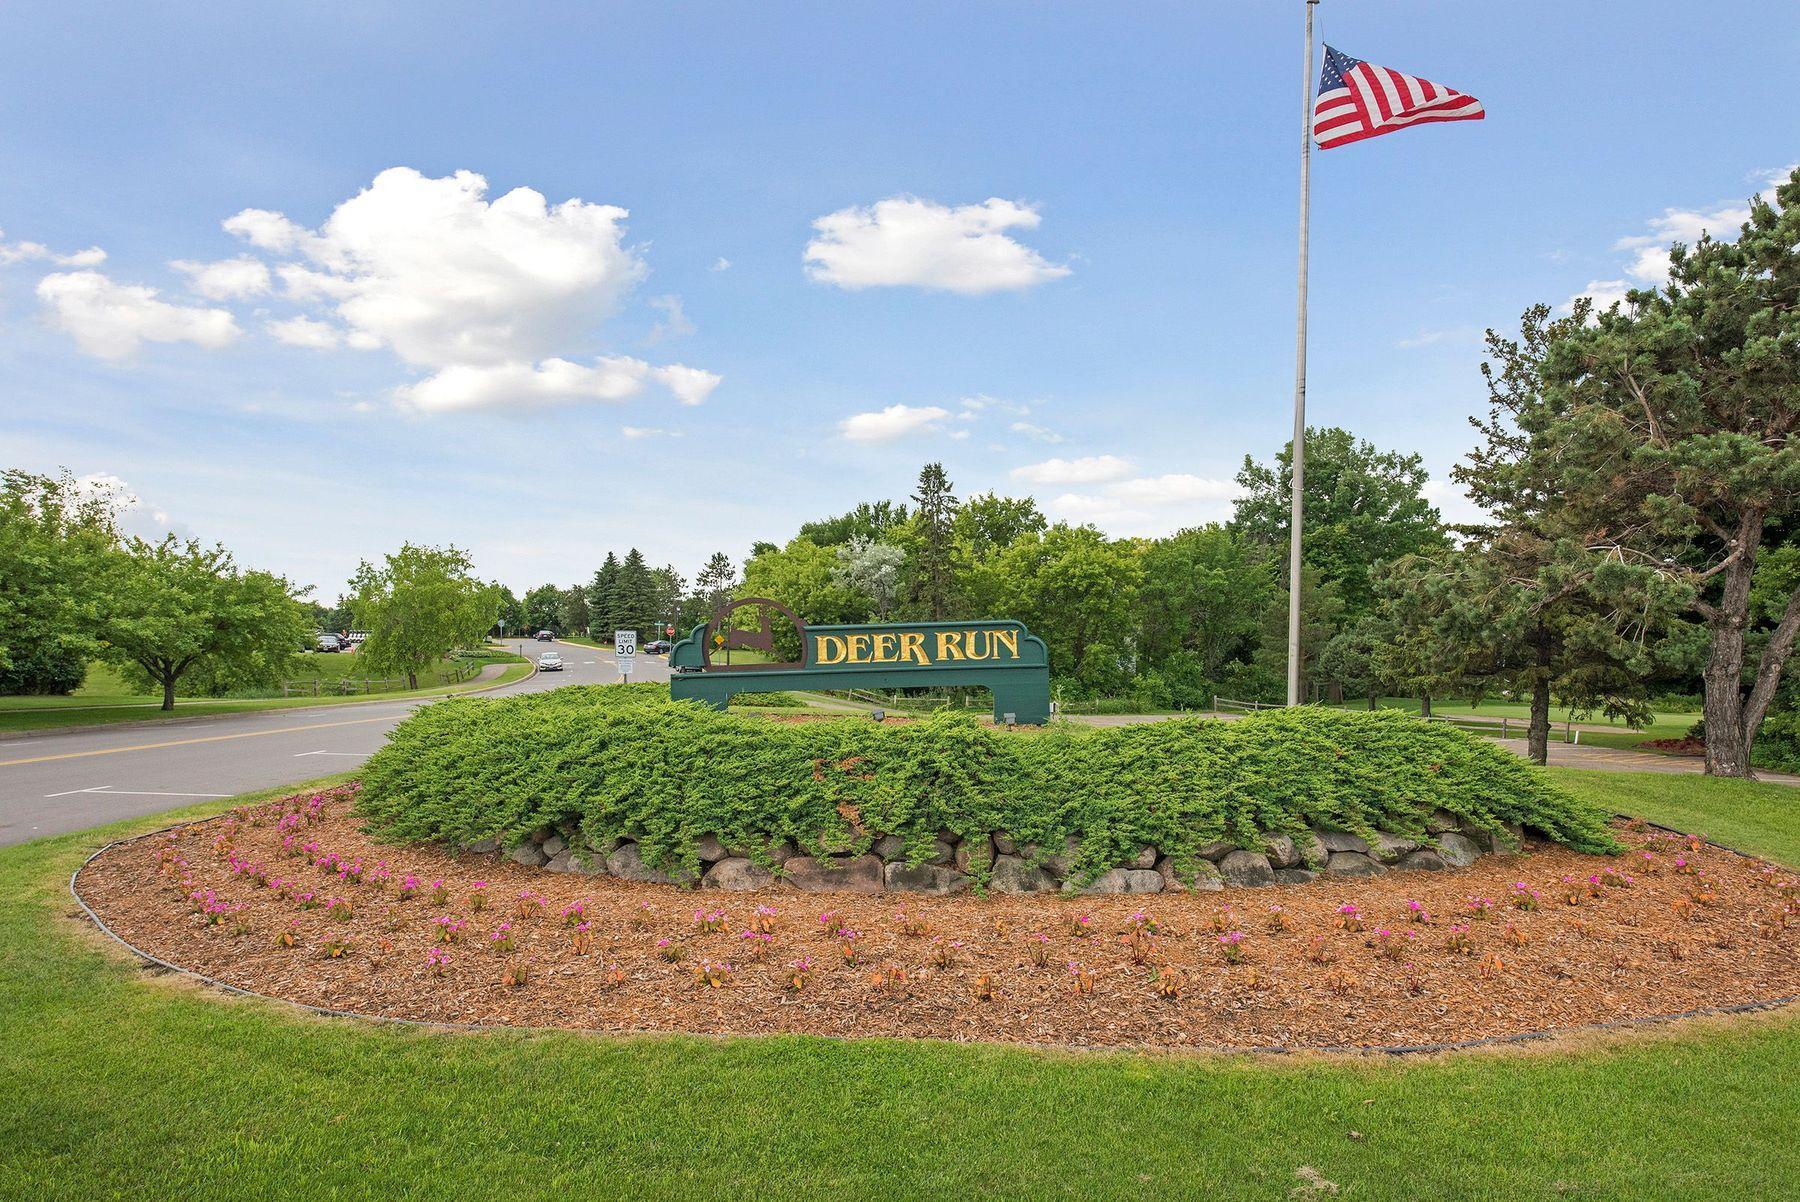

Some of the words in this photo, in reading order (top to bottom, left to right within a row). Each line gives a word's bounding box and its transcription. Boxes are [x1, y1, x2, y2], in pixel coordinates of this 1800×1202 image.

[617, 644, 634, 655] 30
[815, 632, 932, 666] DEER
[934, 629, 1021, 661] RUN
